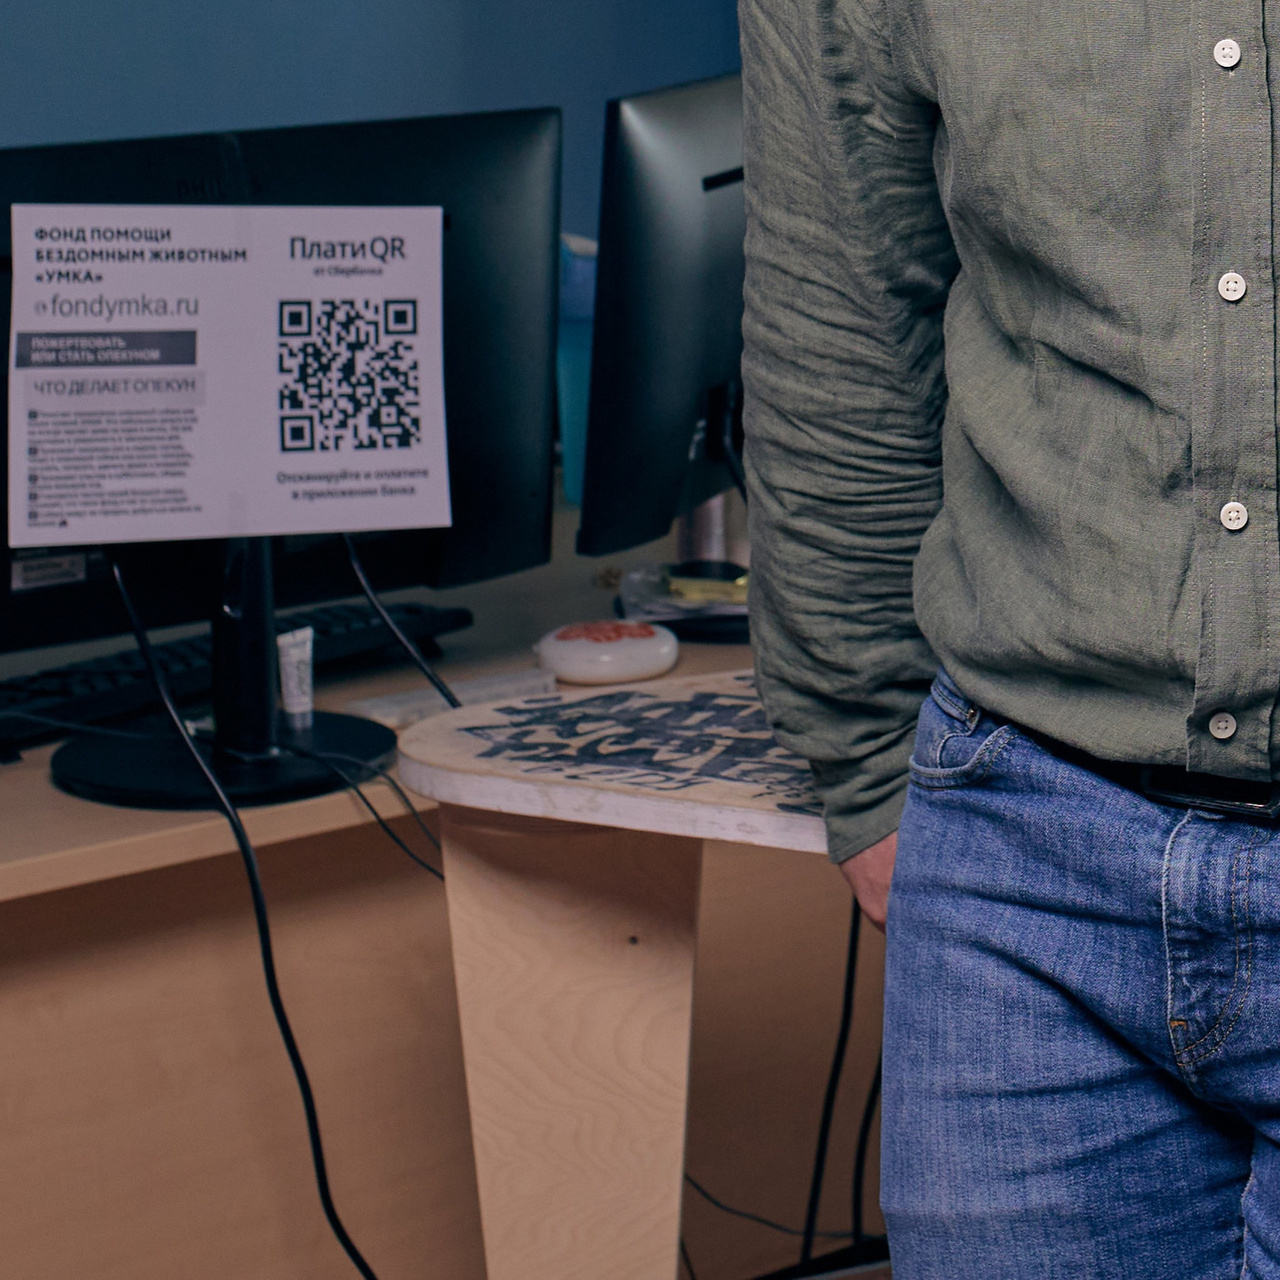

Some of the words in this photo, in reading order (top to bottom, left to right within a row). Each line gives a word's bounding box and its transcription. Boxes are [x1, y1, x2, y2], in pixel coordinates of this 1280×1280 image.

[34, 227, 86, 243] ФОНД
[91, 227, 172, 242] ПОМОЩИ
[35, 248, 145, 263] БЕЗДОМНЫМ
[149, 248, 247, 263] ЖИВОТНЫМ
[35, 270, 103, 284] «УМКА»
[51, 293, 199, 322] fondymka.ru
[30, 336, 127, 350] ПОЖЕРТВОВАТЬ
[58, 350, 93, 363] СТАТЬ
[34, 380, 66, 395] ЧТО
[69, 379, 129, 395] ДЕЛАЕТ
[133, 378, 196, 391] ОПЕКУН
